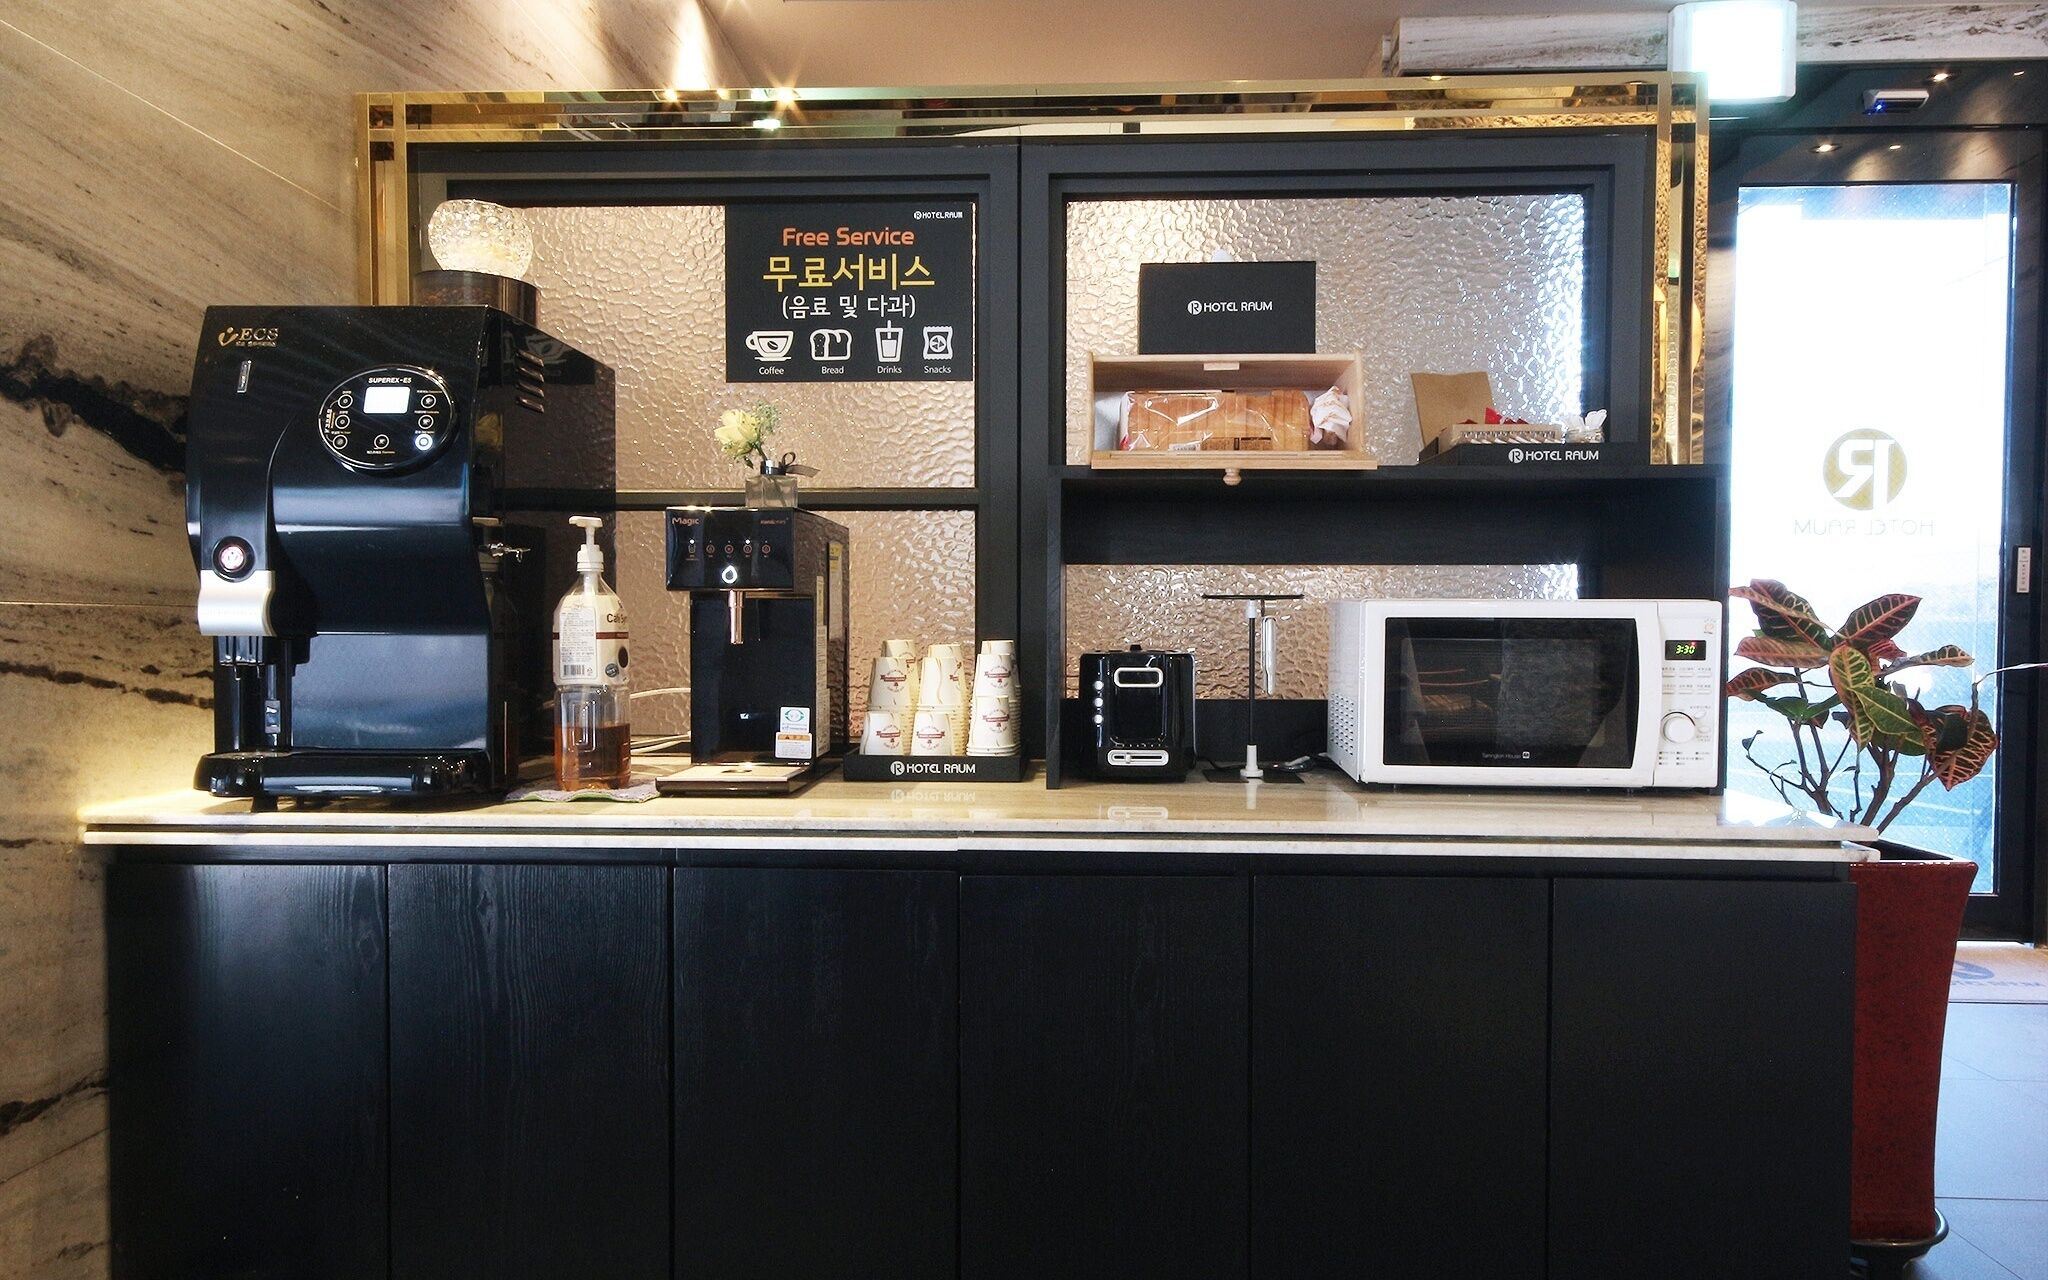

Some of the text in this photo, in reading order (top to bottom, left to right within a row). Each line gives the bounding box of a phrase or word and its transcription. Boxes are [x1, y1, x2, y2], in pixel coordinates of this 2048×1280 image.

[783, 226, 915, 246] Free Service
[763, 253, 935, 293] 무료서비스
[782, 294, 916, 319] (음료 및 다과)
[1203, 301, 1238, 313] HOTEL
[1240, 301, 1273, 312] RAUM
[239, 328, 279, 341] ECS
[758, 366, 785, 375] Coffee
[821, 366, 845, 374] Bread
[877, 365, 902, 374] Drinks
[924, 365, 952, 374] Snacks
[1525, 450, 1562, 461] HOTEL
[1565, 450, 1599, 461] RAUM
[672, 517, 700, 527] Magic
[1675, 644, 1696, 655] 3:30
[906, 764, 941, 774] HOTEL
[943, 763, 976, 774] RAUM
